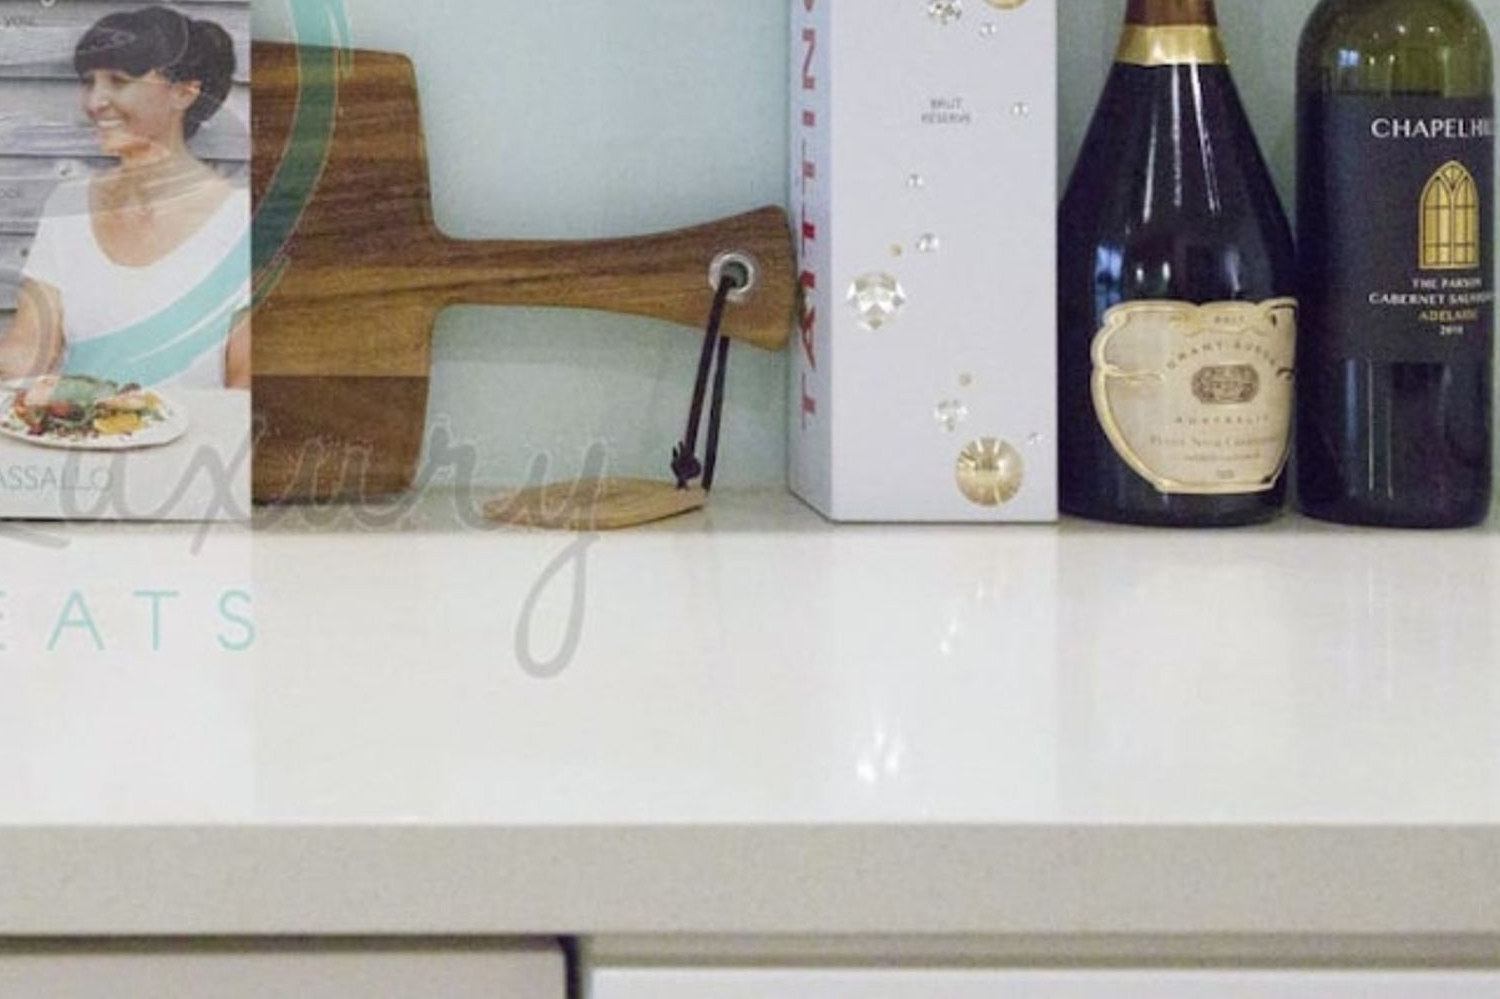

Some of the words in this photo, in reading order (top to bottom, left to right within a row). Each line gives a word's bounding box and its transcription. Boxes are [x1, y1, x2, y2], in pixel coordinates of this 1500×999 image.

[1370, 117, 1468, 138] CHAPEL
[1412, 278, 1437, 289] THE
[1368, 292, 1445, 305] CABERNET
